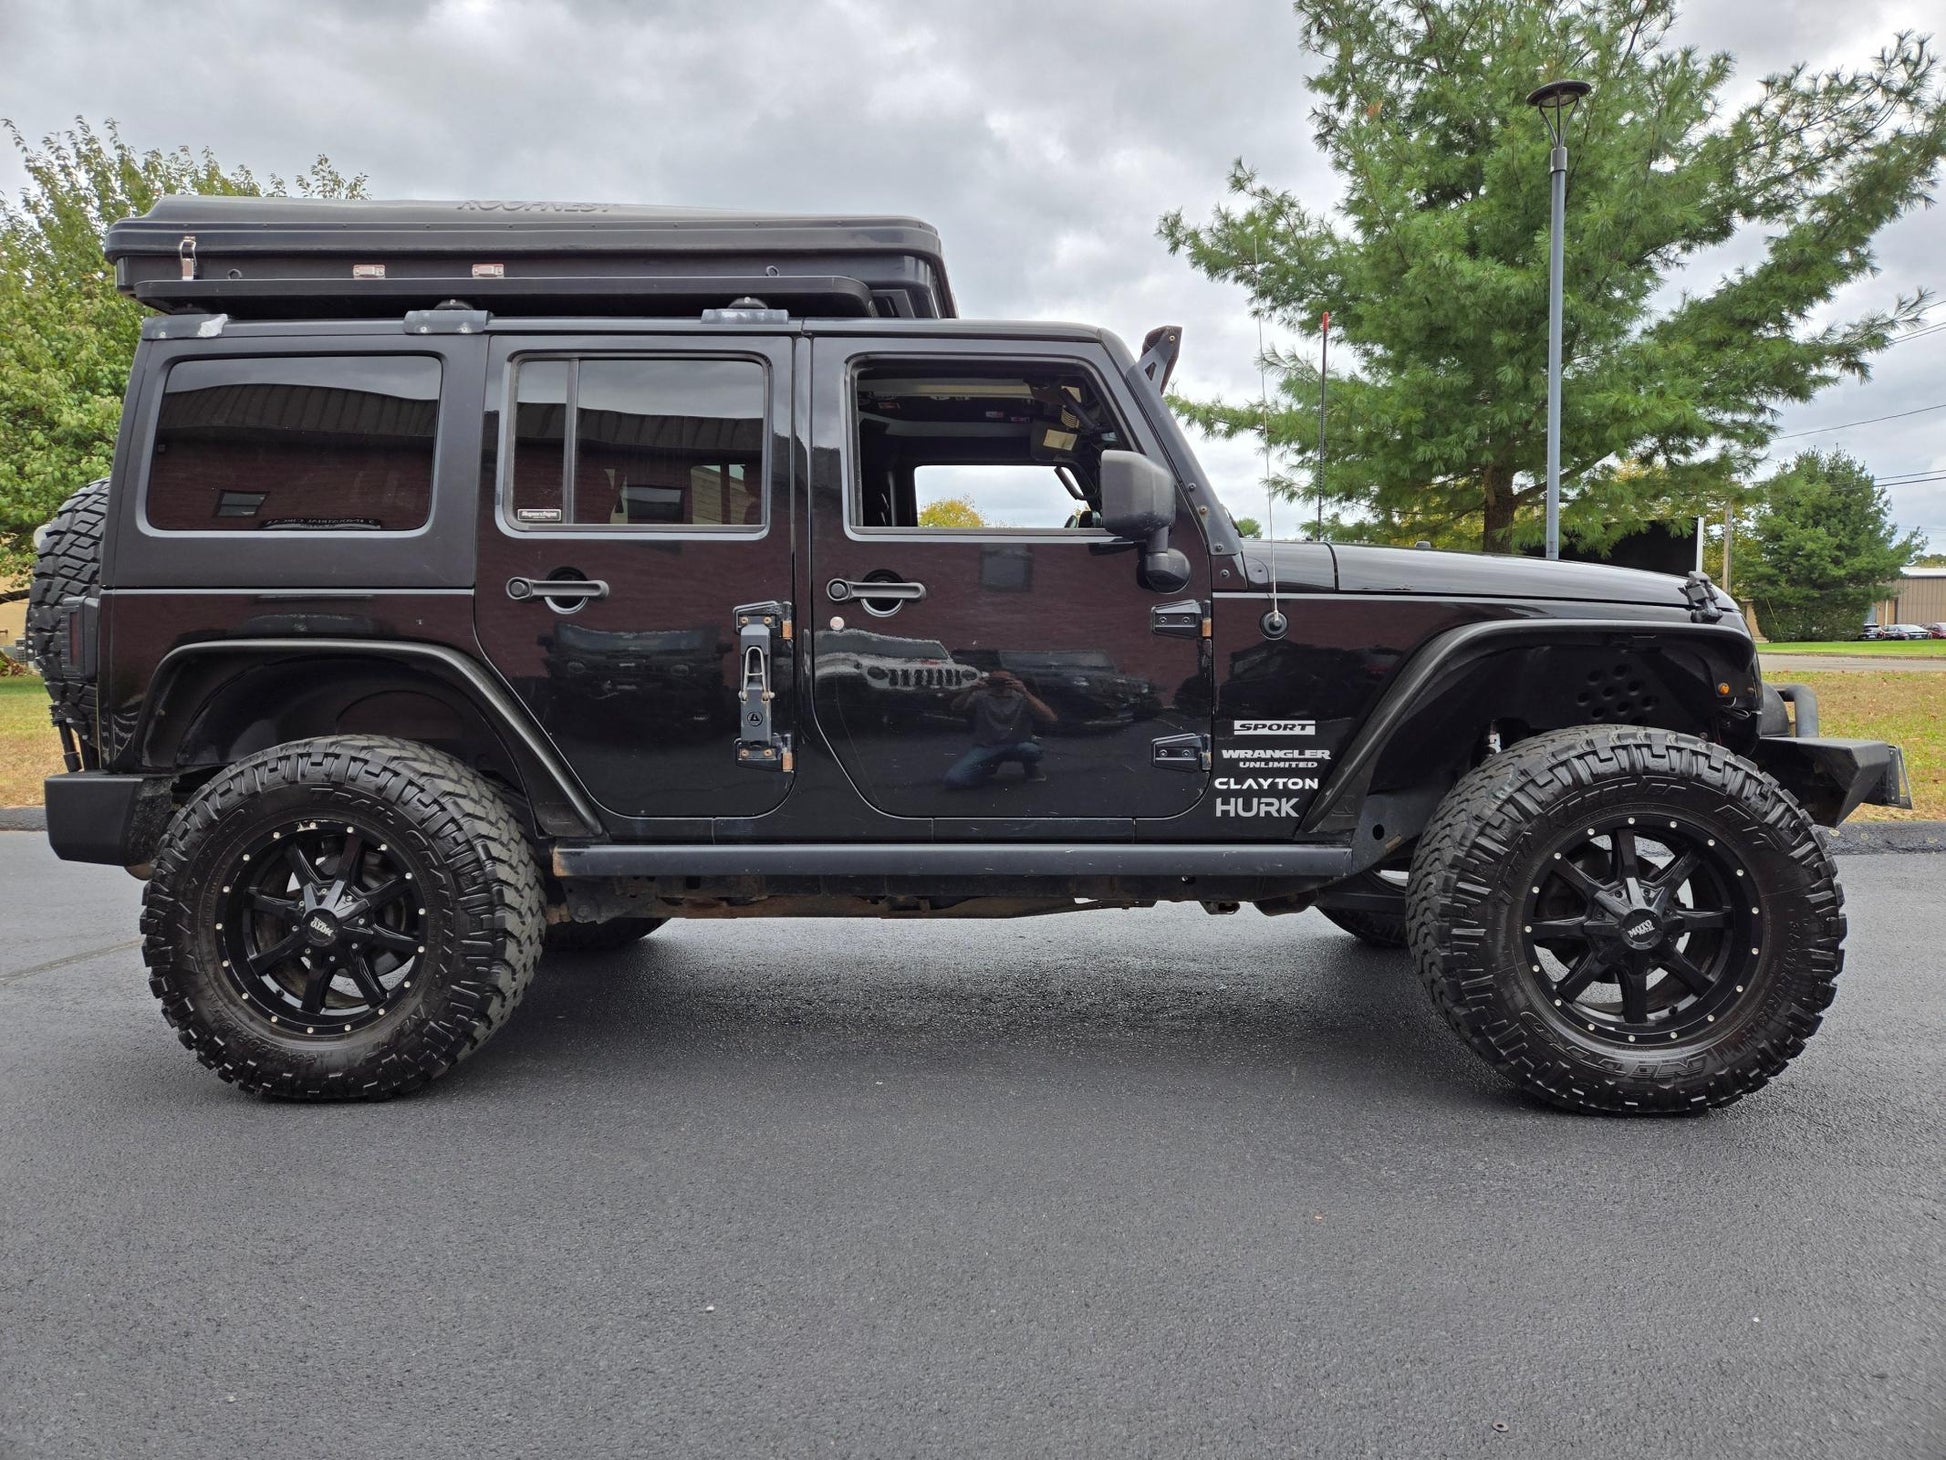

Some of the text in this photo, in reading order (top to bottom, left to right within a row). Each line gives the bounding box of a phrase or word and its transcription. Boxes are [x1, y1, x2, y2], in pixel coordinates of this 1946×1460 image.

[1235, 722, 1311, 732] SPORT
[1221, 749, 1331, 760] WRANGLER
[1214, 777, 1319, 790] CLAYTON
[1215, 797, 1300, 818] HURK
[1627, 919, 1653, 938] MOTO
